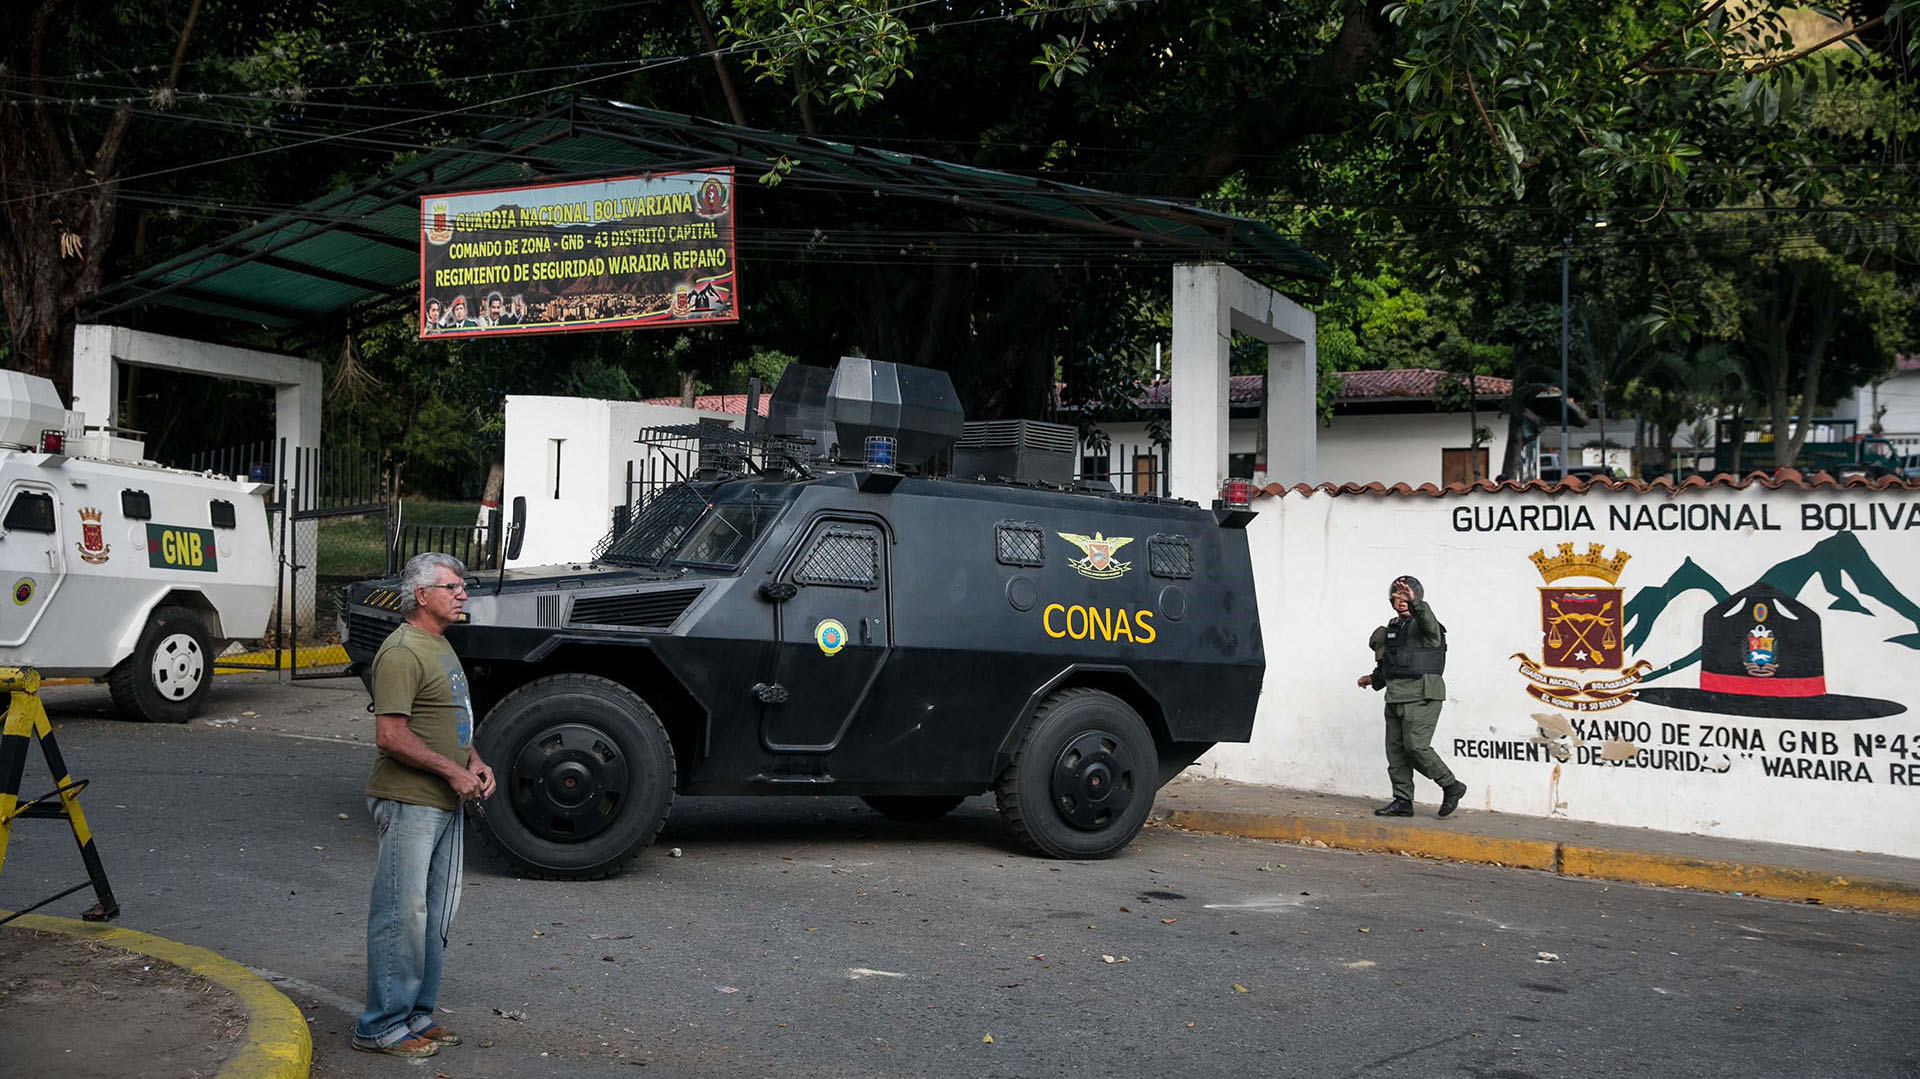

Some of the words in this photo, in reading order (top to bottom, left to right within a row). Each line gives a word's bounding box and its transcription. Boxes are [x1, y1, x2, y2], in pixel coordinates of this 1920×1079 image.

[456, 209, 516, 232] GUARDIA
[520, 202, 590, 227] NACIONAL
[594, 192, 693, 221] BOLIVARIANA
[449, 240, 502, 260] COMANDO
[505, 239, 519, 255] DE
[521, 237, 551, 254] ZONA
[561, 234, 584, 251] GNB
[595, 231, 608, 248] 43
[611, 226, 666, 247] DISTRITO
[669, 222, 718, 241] CAPITAL
[435, 265, 511, 287] REGIMIENTO
[513, 263, 530, 282] DE
[532, 258, 605, 281] SEGURIDAD
[608, 253, 670, 275] WARAIRA
[673, 248, 727, 270] REPANO
[1452, 504, 1595, 532] GUARDIA
[1609, 503, 1782, 531] NACIONAL
[1801, 502, 1920, 530] BOLIVA
[162, 529, 203, 566] GNB
[1043, 603, 1157, 644] CONAS
[1521, 666, 1547, 684] GUARDIA
[1549, 677, 1581, 690] NACIONAL
[1591, 676, 1637, 690] BOLIVARIANA
[1541, 693, 1550, 702] EL
[1551, 698, 1574, 709] HONOR
[1589, 701, 1599, 711] SU
[1538, 718, 1651, 743] MANDO
[1662, 722, 1690, 746] DE
[1699, 725, 1766, 751] ZONA
[1779, 730, 1839, 756] GNB
[1577, 746, 1604, 766] DE
